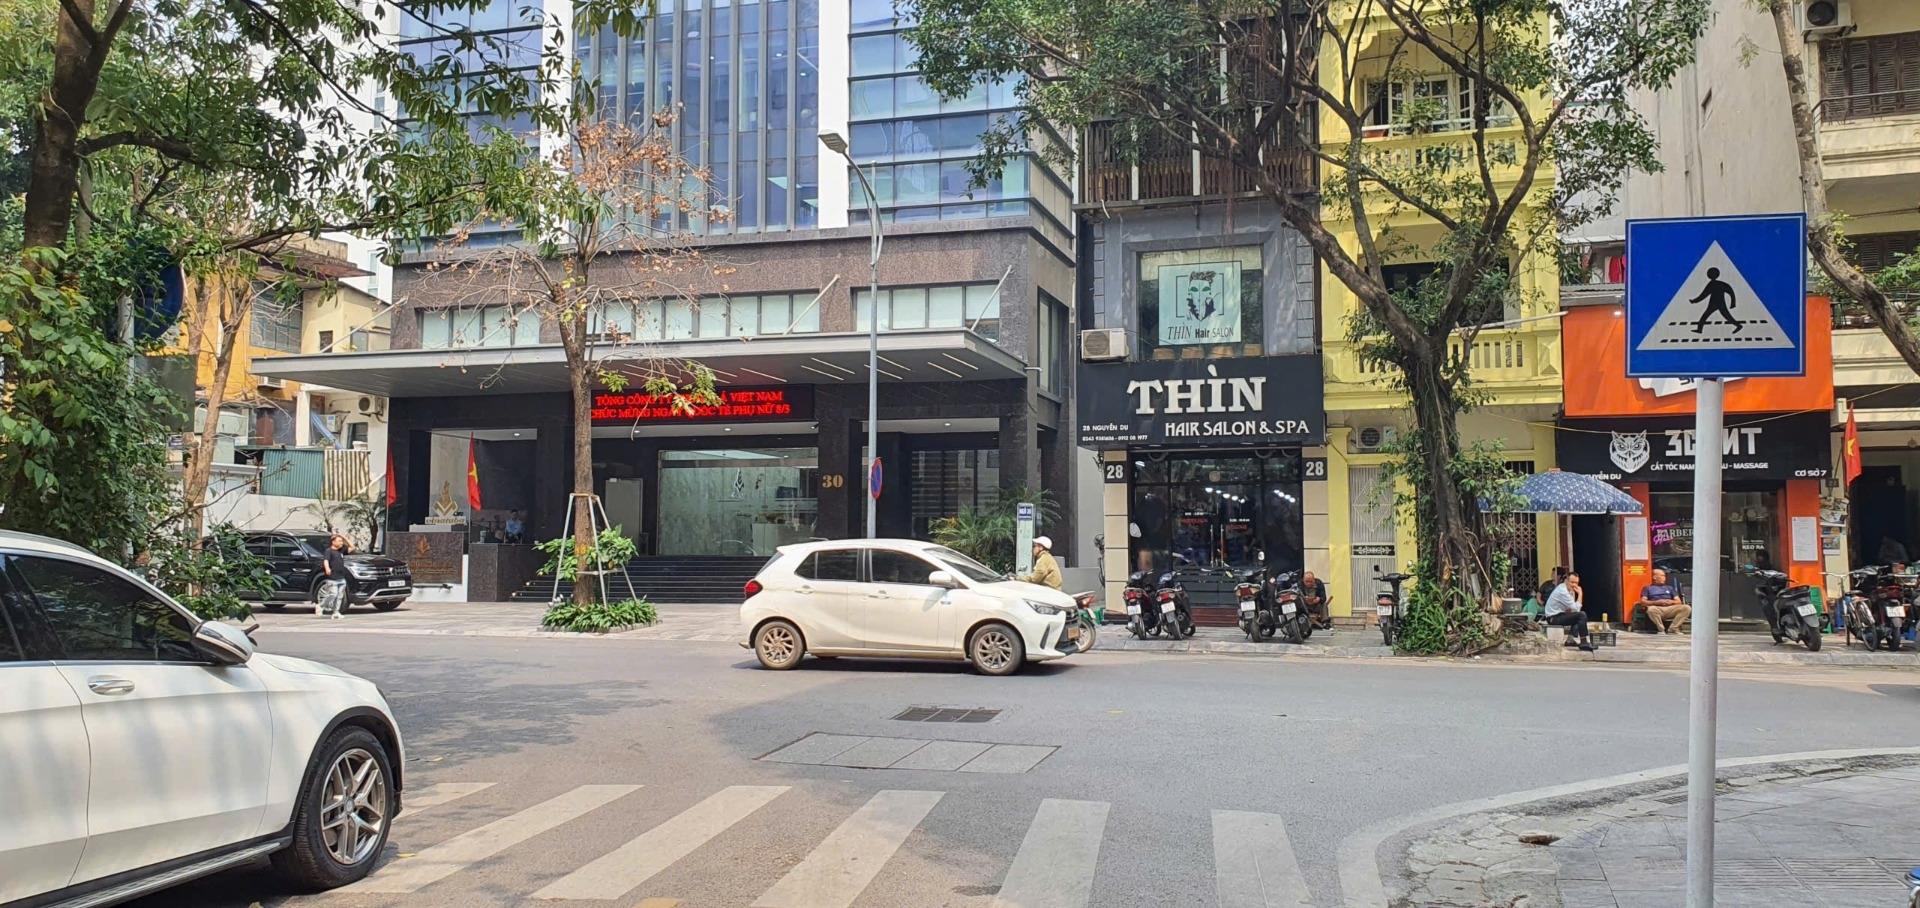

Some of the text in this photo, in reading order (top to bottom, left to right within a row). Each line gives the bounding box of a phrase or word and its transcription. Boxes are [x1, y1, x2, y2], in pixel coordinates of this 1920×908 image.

[1195, 328, 1210, 339] Hair
[1212, 326, 1234, 338] SALON
[730, 391, 754, 402] VIỆT
[756, 391, 783, 401] NAM
[1126, 364, 1267, 415] THÌN
[733, 404, 755, 416] PHỤ
[757, 402, 774, 414] NỮ
[1165, 420, 1310, 437] HAIR SALON & SPA
[1106, 464, 1124, 479] 28
[1305, 461, 1324, 476] 28
[1665, 461, 1678, 471] TÓC
[1679, 463, 1695, 471] NAM
[1795, 469, 1807, 477] CƠ
[1807, 468, 1820, 477] SỞ
[822, 474, 844, 488] 30
